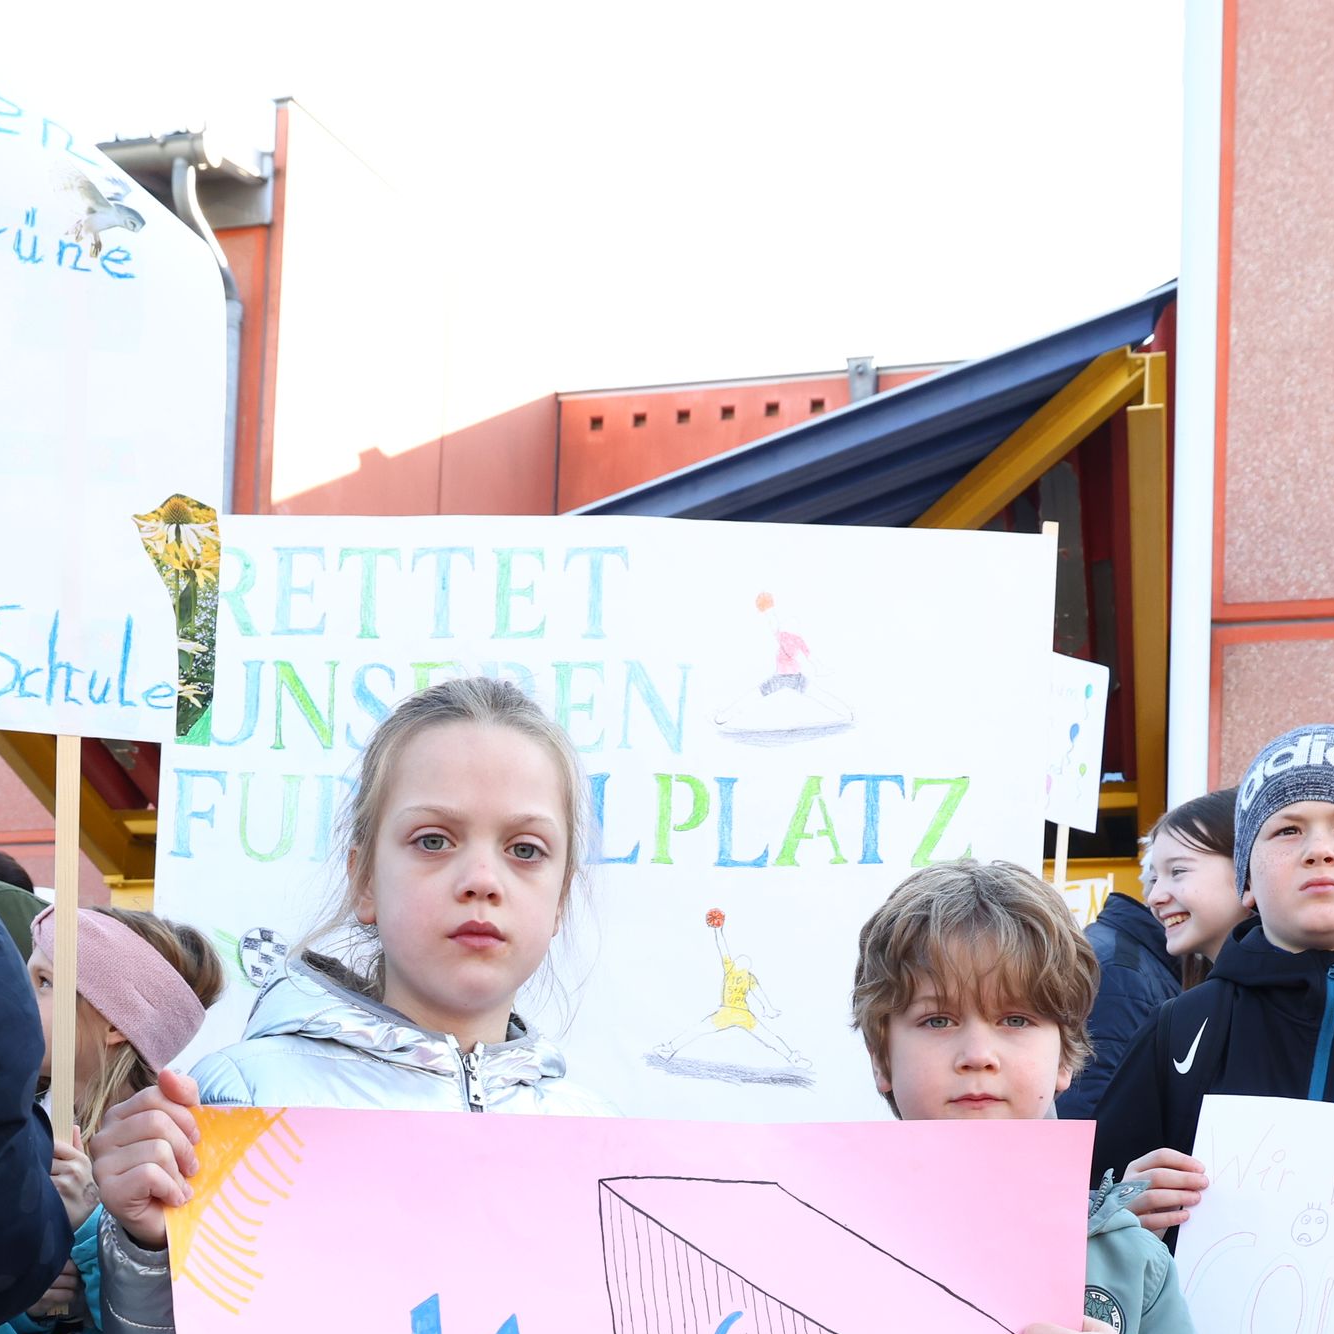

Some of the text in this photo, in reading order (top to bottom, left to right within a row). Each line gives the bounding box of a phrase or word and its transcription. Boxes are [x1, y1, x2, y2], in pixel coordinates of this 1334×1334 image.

[219, 546, 630, 640] RETTET
[210, 660, 693, 753] UNSEN
[1211, 1123, 1296, 1193] Wir
